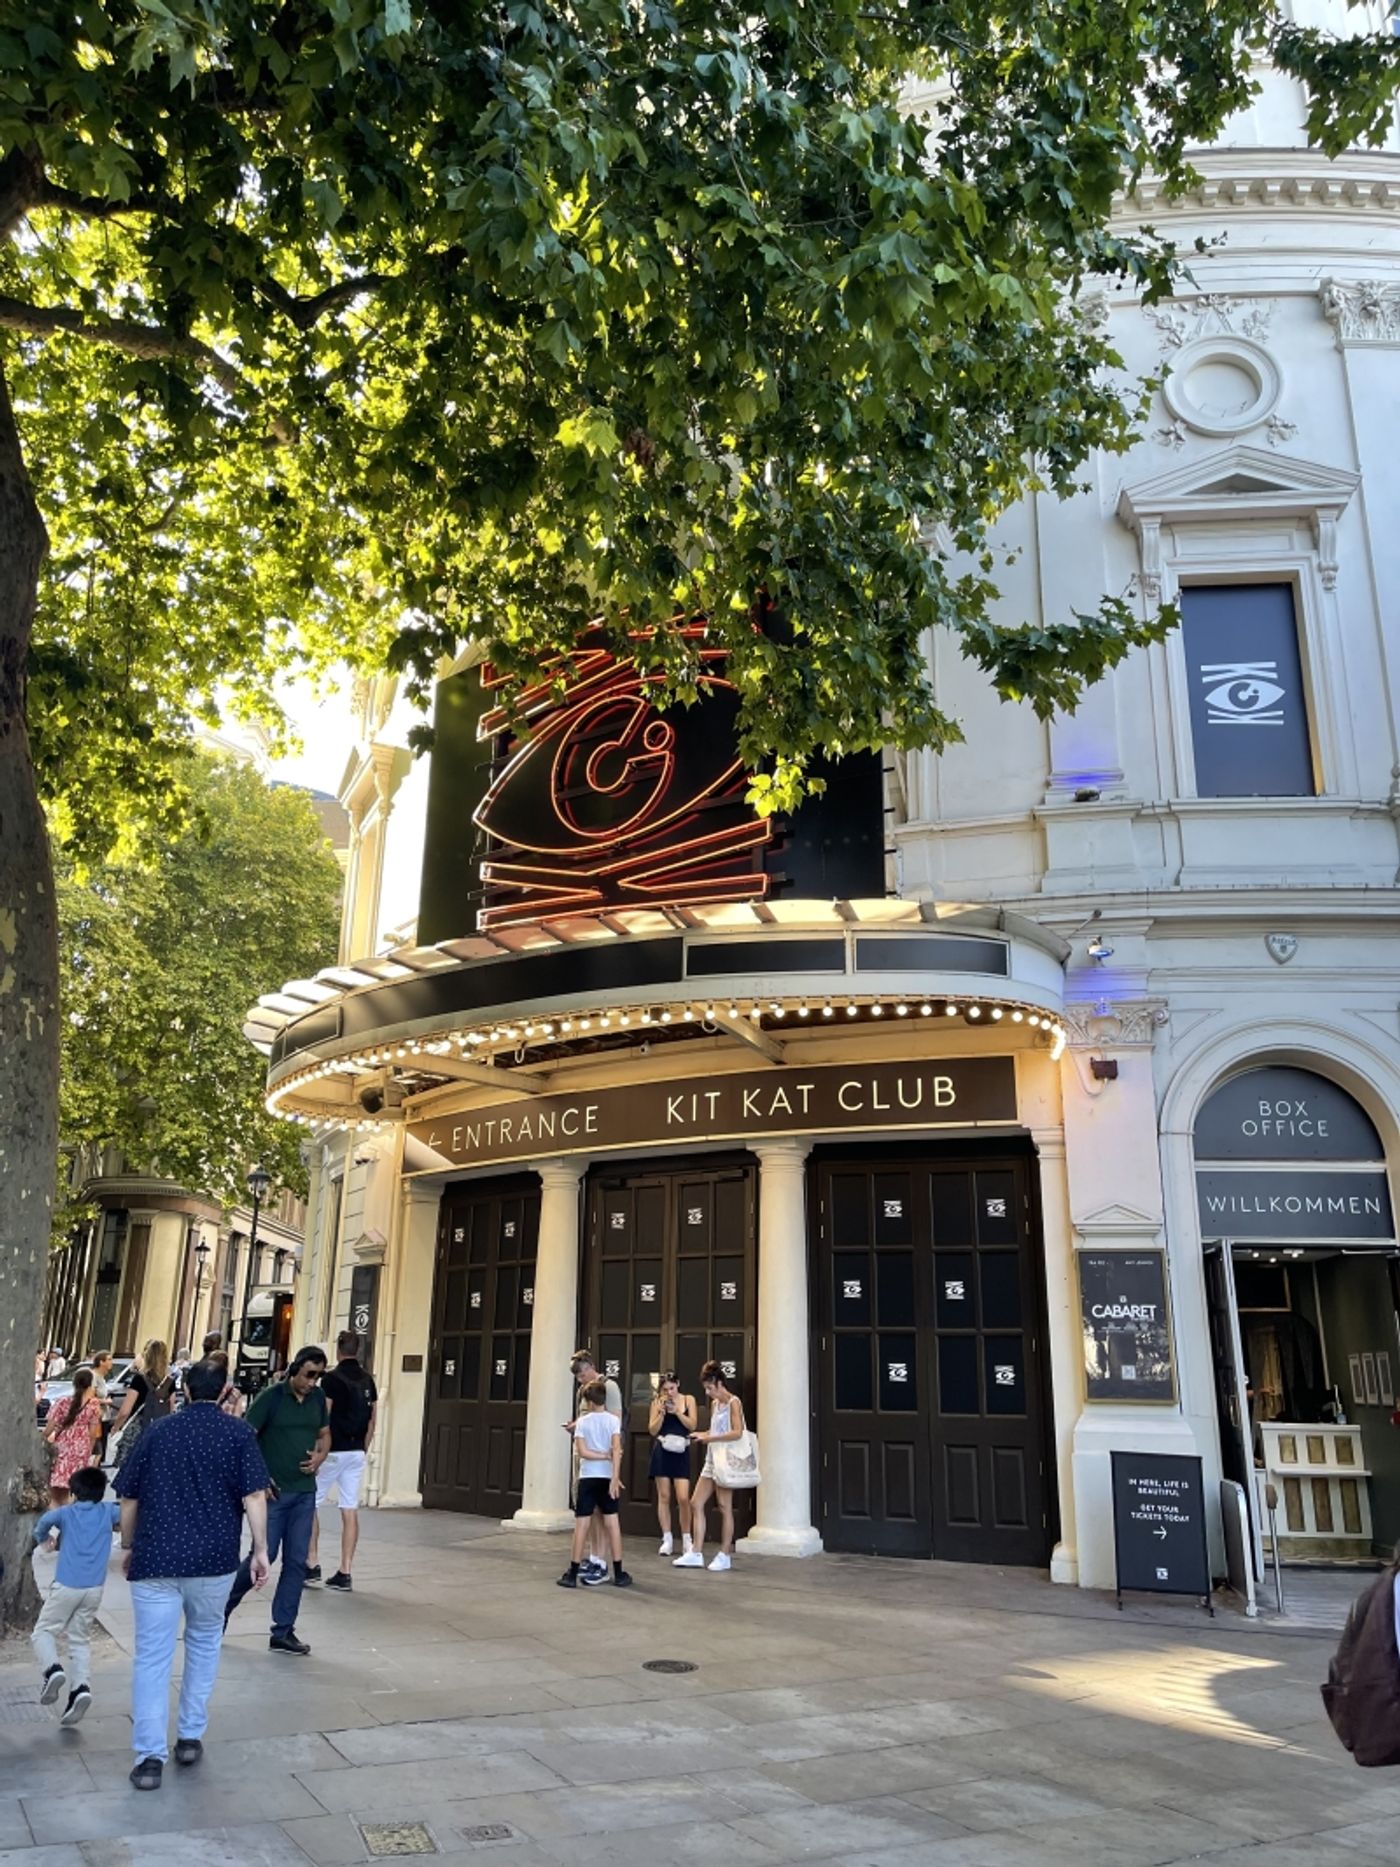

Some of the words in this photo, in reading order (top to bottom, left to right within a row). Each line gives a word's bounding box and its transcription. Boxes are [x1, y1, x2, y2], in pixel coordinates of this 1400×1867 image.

[452, 1105, 598, 1152] ENTRANCE
[667, 1092, 721, 1124] KIT
[743, 1085, 815, 1118] KAT
[838, 1076, 956, 1111] CLUB
[1259, 1100, 1308, 1116] BOX
[1241, 1120, 1329, 1137] OFFICE
[1206, 1196, 1380, 1214] WILLKOMMEN
[1091, 1304, 1157, 1321] CABARET
[1157, 1505, 1179, 1513] YOUR
